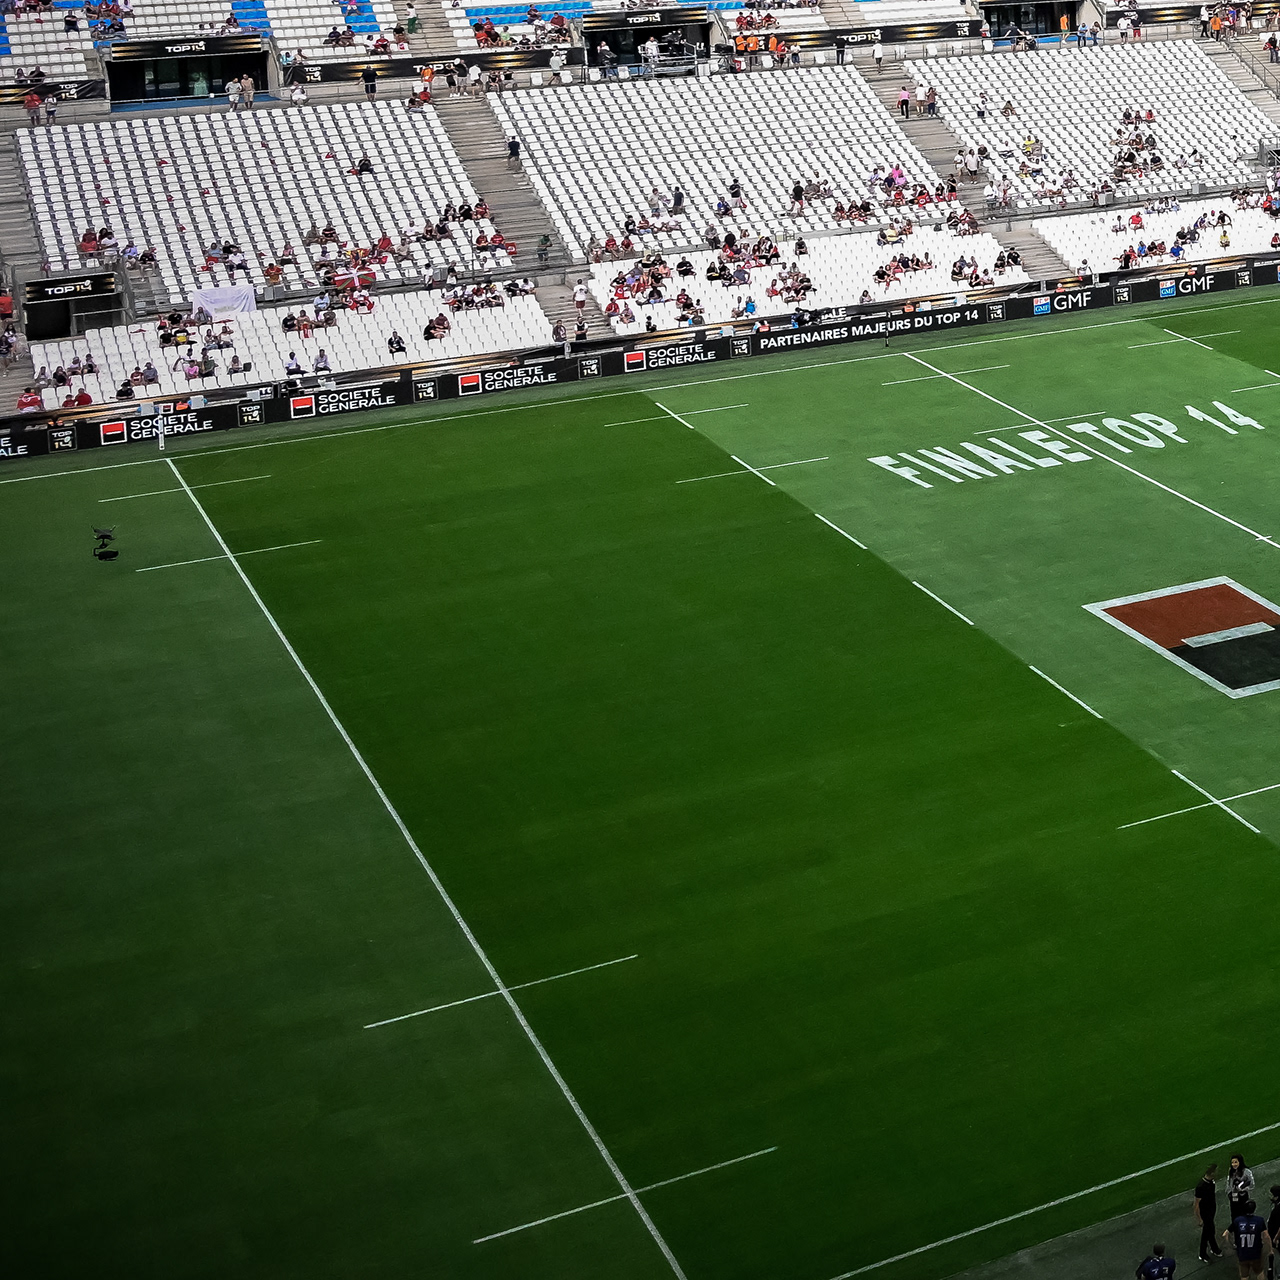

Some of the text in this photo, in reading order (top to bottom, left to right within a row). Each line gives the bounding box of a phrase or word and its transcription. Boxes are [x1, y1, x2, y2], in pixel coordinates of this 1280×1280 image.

[165, 42, 205, 53] TOP14
[45, 282, 92, 296] TOP14
[1179, 276, 1214, 294] GMF
[1054, 292, 1092, 311] GMF
[760, 310, 979, 349] PARTENAIRES MAJEURS DU TOP 14
[648, 344, 703, 360] SOCIETE
[734, 346, 748, 355] 14
[649, 351, 716, 368] GENERALE
[485, 366, 543, 382] SOCIETE
[583, 366, 598, 376] 14
[485, 373, 557, 391] GENERALE
[318, 387, 381, 404] SOCIETE
[419, 390, 434, 399] 14
[319, 395, 395, 414] GENERALE
[243, 413, 261, 423] 14
[52, 430, 72, 438] TOP
[54, 440, 72, 449] 14
[867, 401, 1266, 488] FINALE TOP 14
[1239, 1233, 1256, 1248] TV
